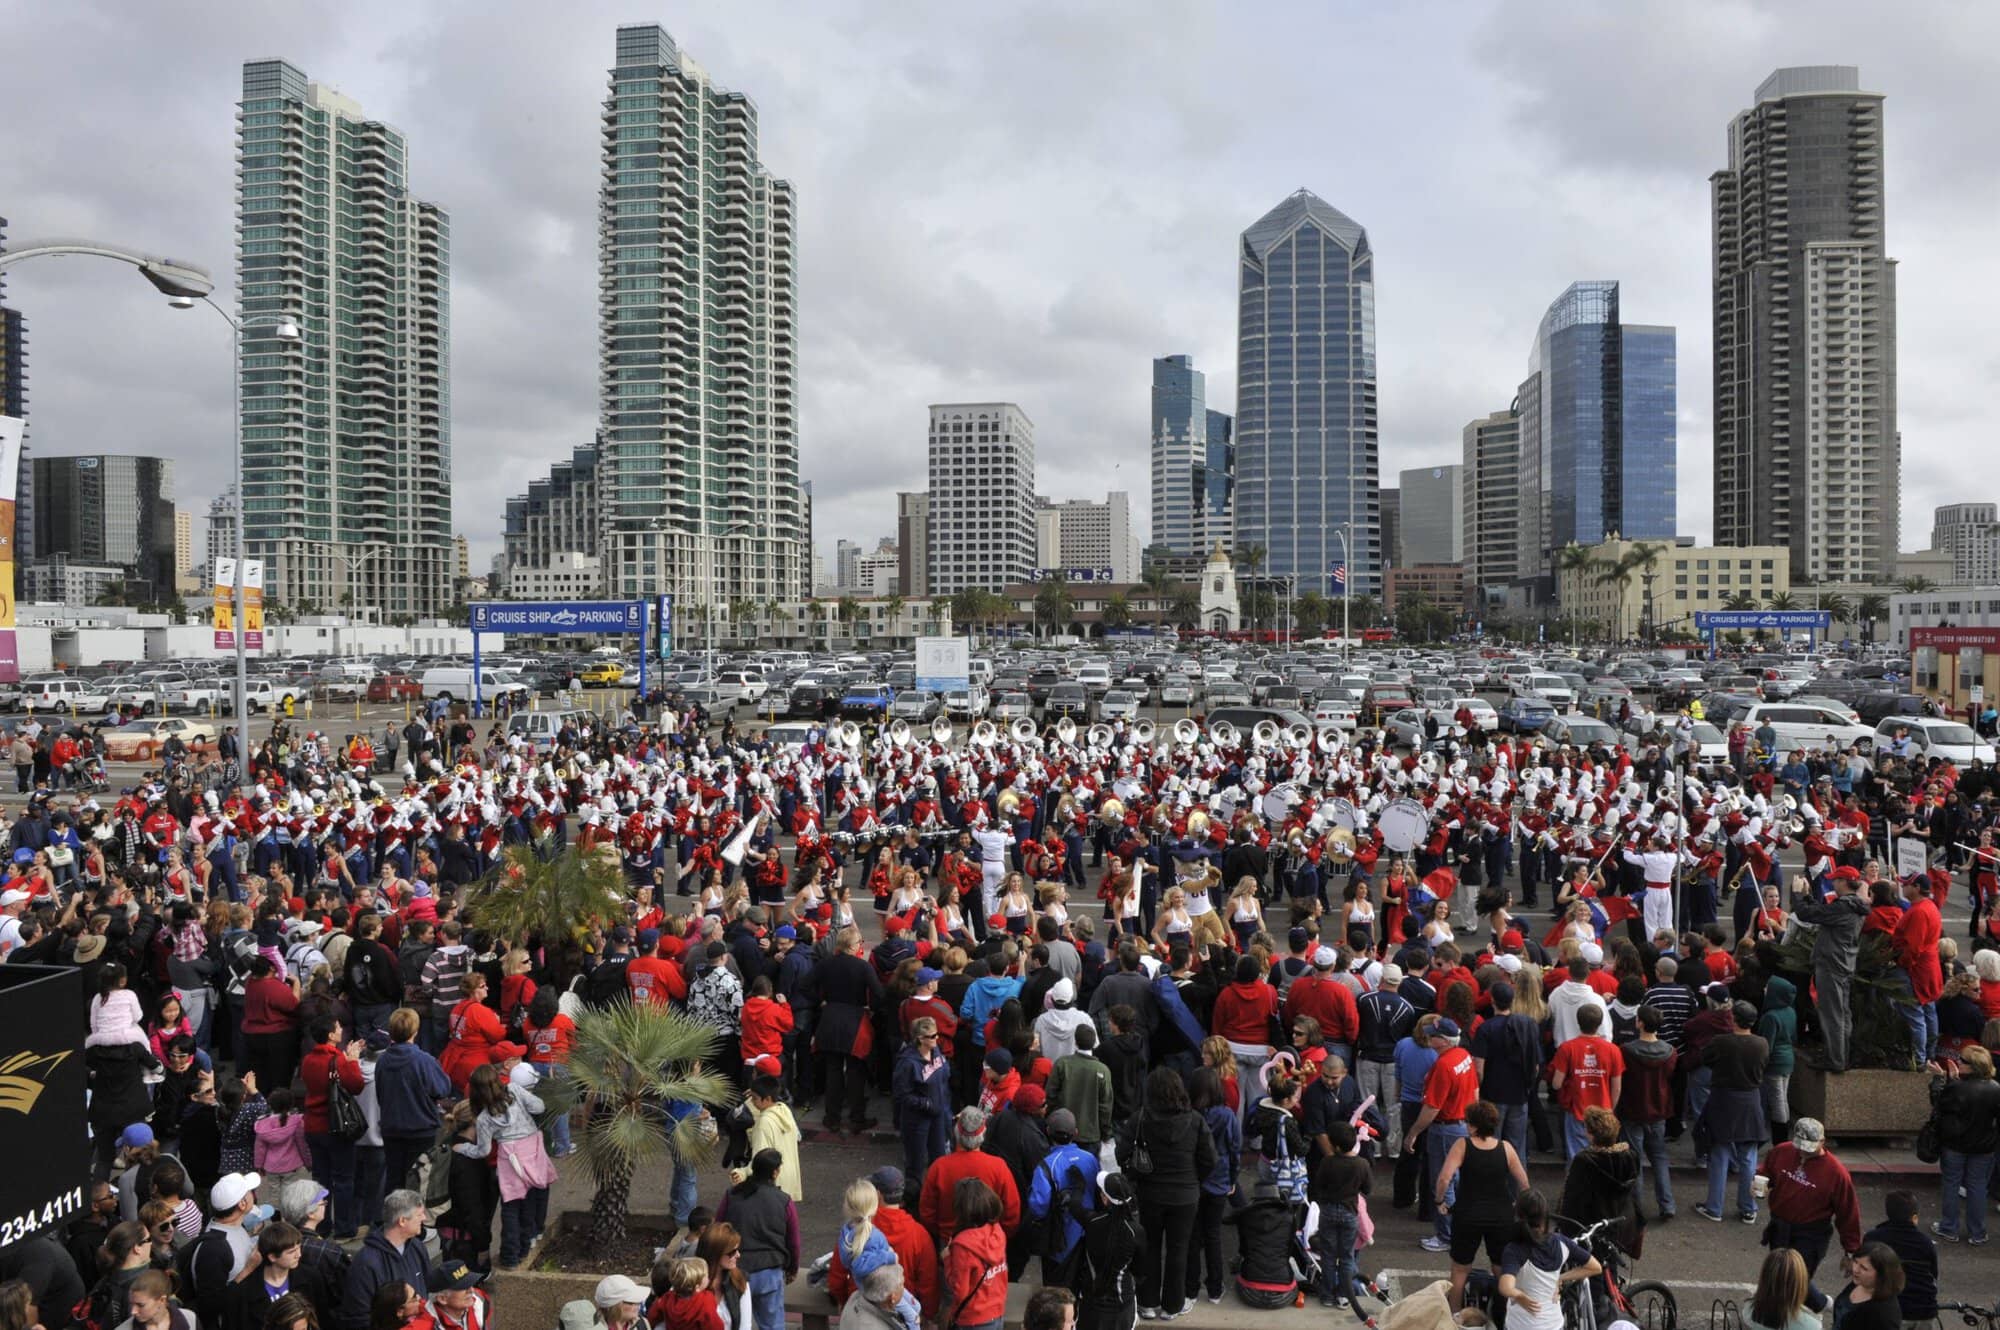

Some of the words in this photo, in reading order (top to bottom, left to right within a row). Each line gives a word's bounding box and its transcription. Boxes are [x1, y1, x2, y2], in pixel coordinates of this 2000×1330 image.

[1034, 569, 1083, 580] Sata
[1093, 569, 1110, 580] Fe
[477, 607, 486, 621] 5
[628, 606, 638, 620] 5
[662, 597, 670, 620] 5
[490, 611, 527, 624] CRUISE
[528, 611, 552, 624] SHIP
[579, 611, 623, 623] PARKING
[1710, 615, 1739, 624] CRUISE
[1740, 615, 1759, 624] SHIP
[1780, 615, 1816, 623] PARKING
[1702, 630, 1710, 639] P
[1933, 635, 1955, 643] VISITOR
[1955, 635, 1996, 644] INFORMATION
[662, 637, 670, 654] P
[0, 1186, 82, 1248] 234.4111
